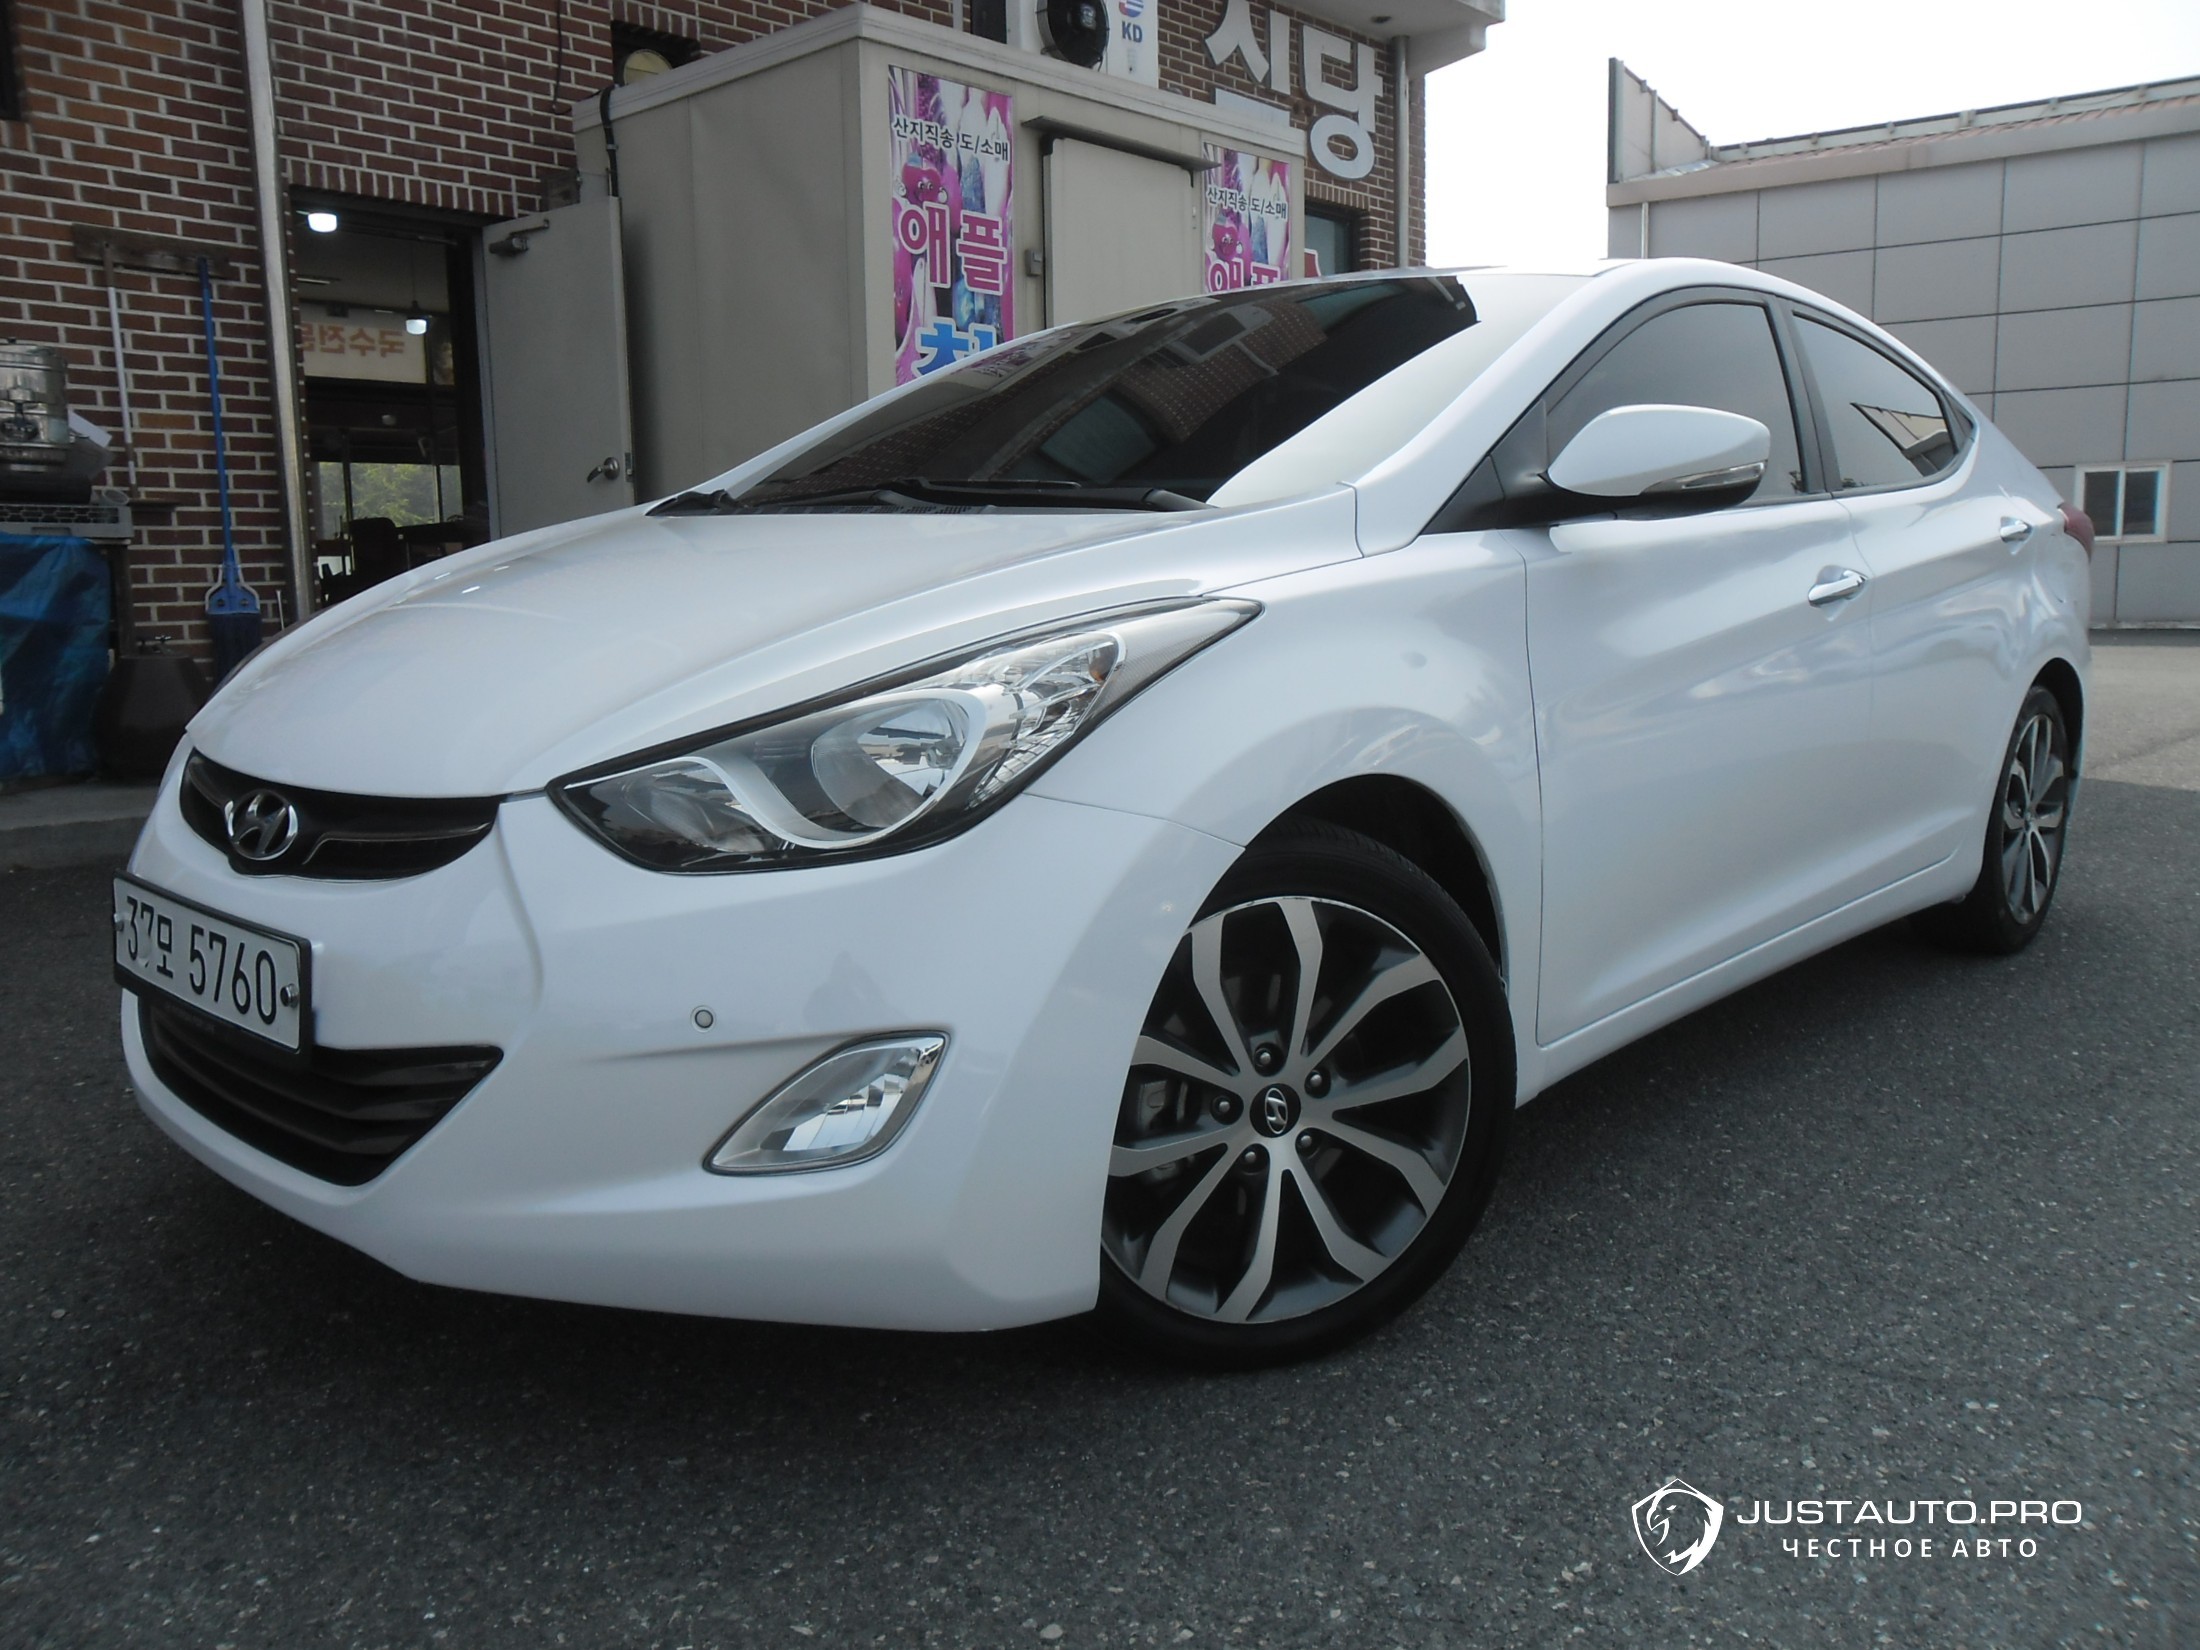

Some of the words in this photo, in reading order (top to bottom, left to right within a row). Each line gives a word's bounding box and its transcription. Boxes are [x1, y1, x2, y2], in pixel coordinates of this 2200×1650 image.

[1122, 21, 1143, 43] KD
[894, 118, 955, 149] 산지직송
[960, 132, 1009, 162] 도/소매
[1207, 186, 1248, 212] 산지직송
[1250, 197, 1288, 219] 도/소매
[899, 202, 1007, 295] 애플
[126, 895, 175, 979] 37모
[189, 924, 277, 1026] 5760
